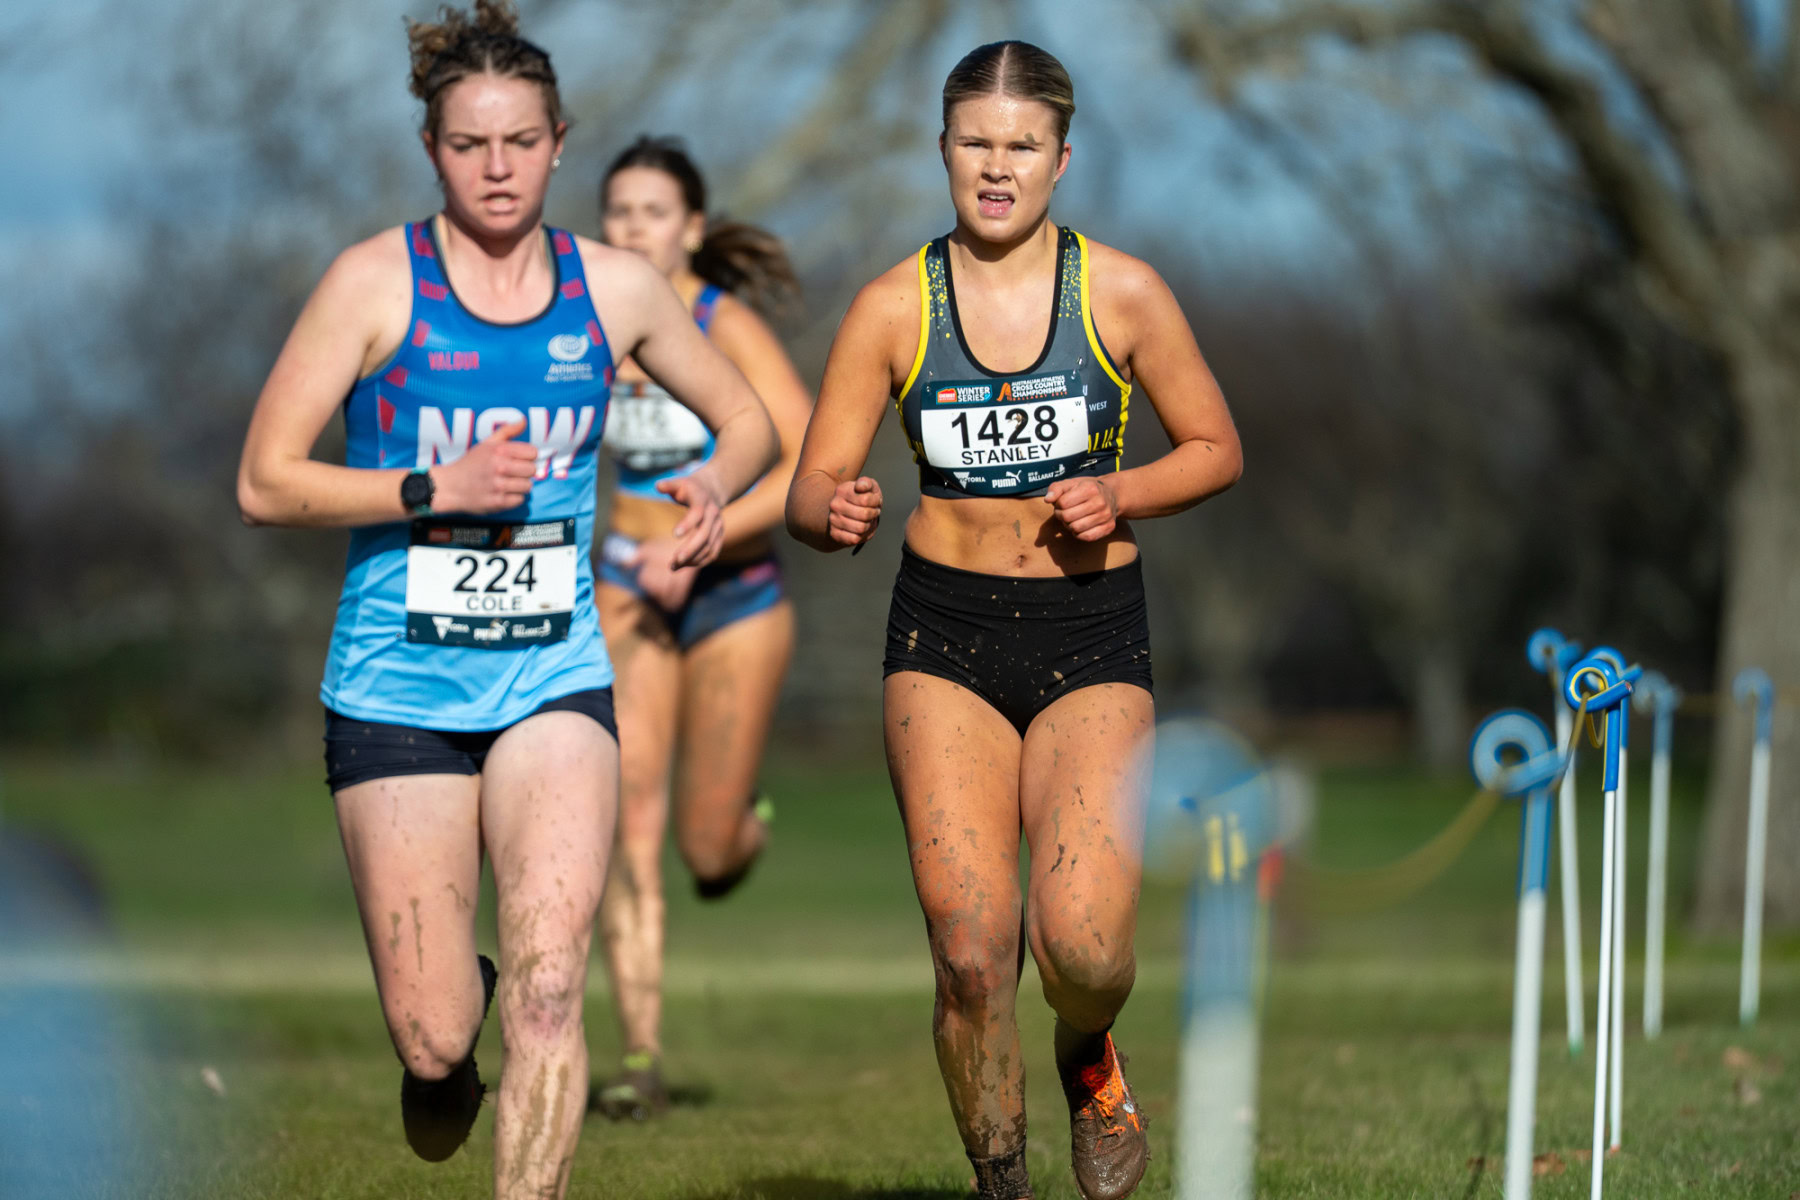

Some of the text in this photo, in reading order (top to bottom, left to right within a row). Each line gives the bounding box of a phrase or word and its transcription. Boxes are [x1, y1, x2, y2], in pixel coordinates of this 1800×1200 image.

[957, 386, 990, 395] WINTER
[1012, 380, 1065, 392] CROSS COUNTRY
[1012, 386, 1067, 397] CHAMPIONSHIPS
[957, 393, 984, 402] SERIES
[1089, 401, 1107, 412] WEST
[951, 405, 1059, 449] 1428
[962, 444, 1052, 465] STANLEY
[992, 478, 1017, 488] PUMA
[453, 555, 537, 593] 224
[466, 596, 522, 611] COLE
